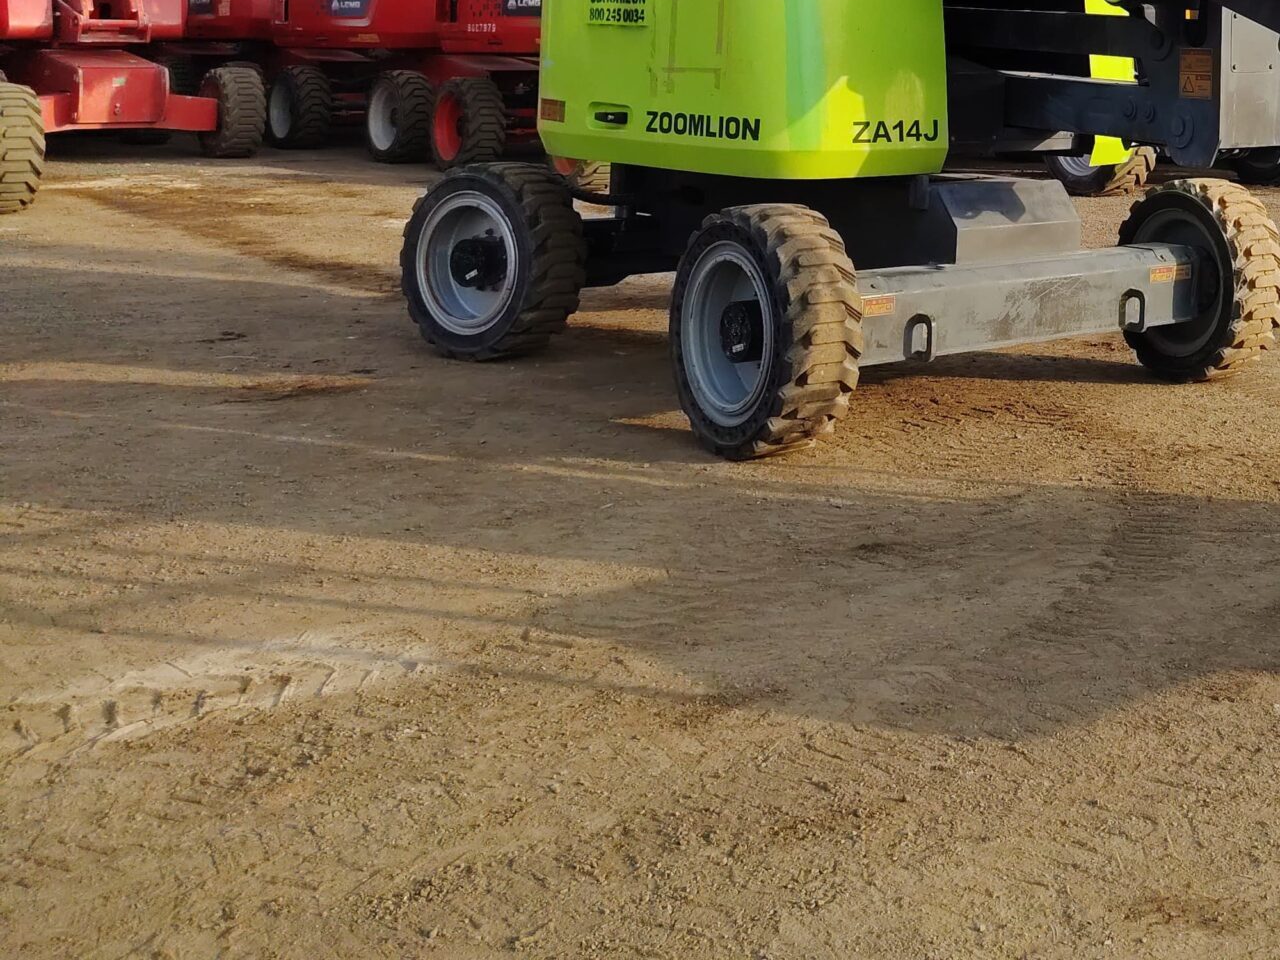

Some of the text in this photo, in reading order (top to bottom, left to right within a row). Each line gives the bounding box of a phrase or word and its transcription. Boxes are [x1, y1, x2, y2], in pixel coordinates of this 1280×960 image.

[590, 8, 645, 23] 800 245 0034
[645, 110, 760, 141] ZOOMLION
[852, 119, 939, 143] ZA14J
